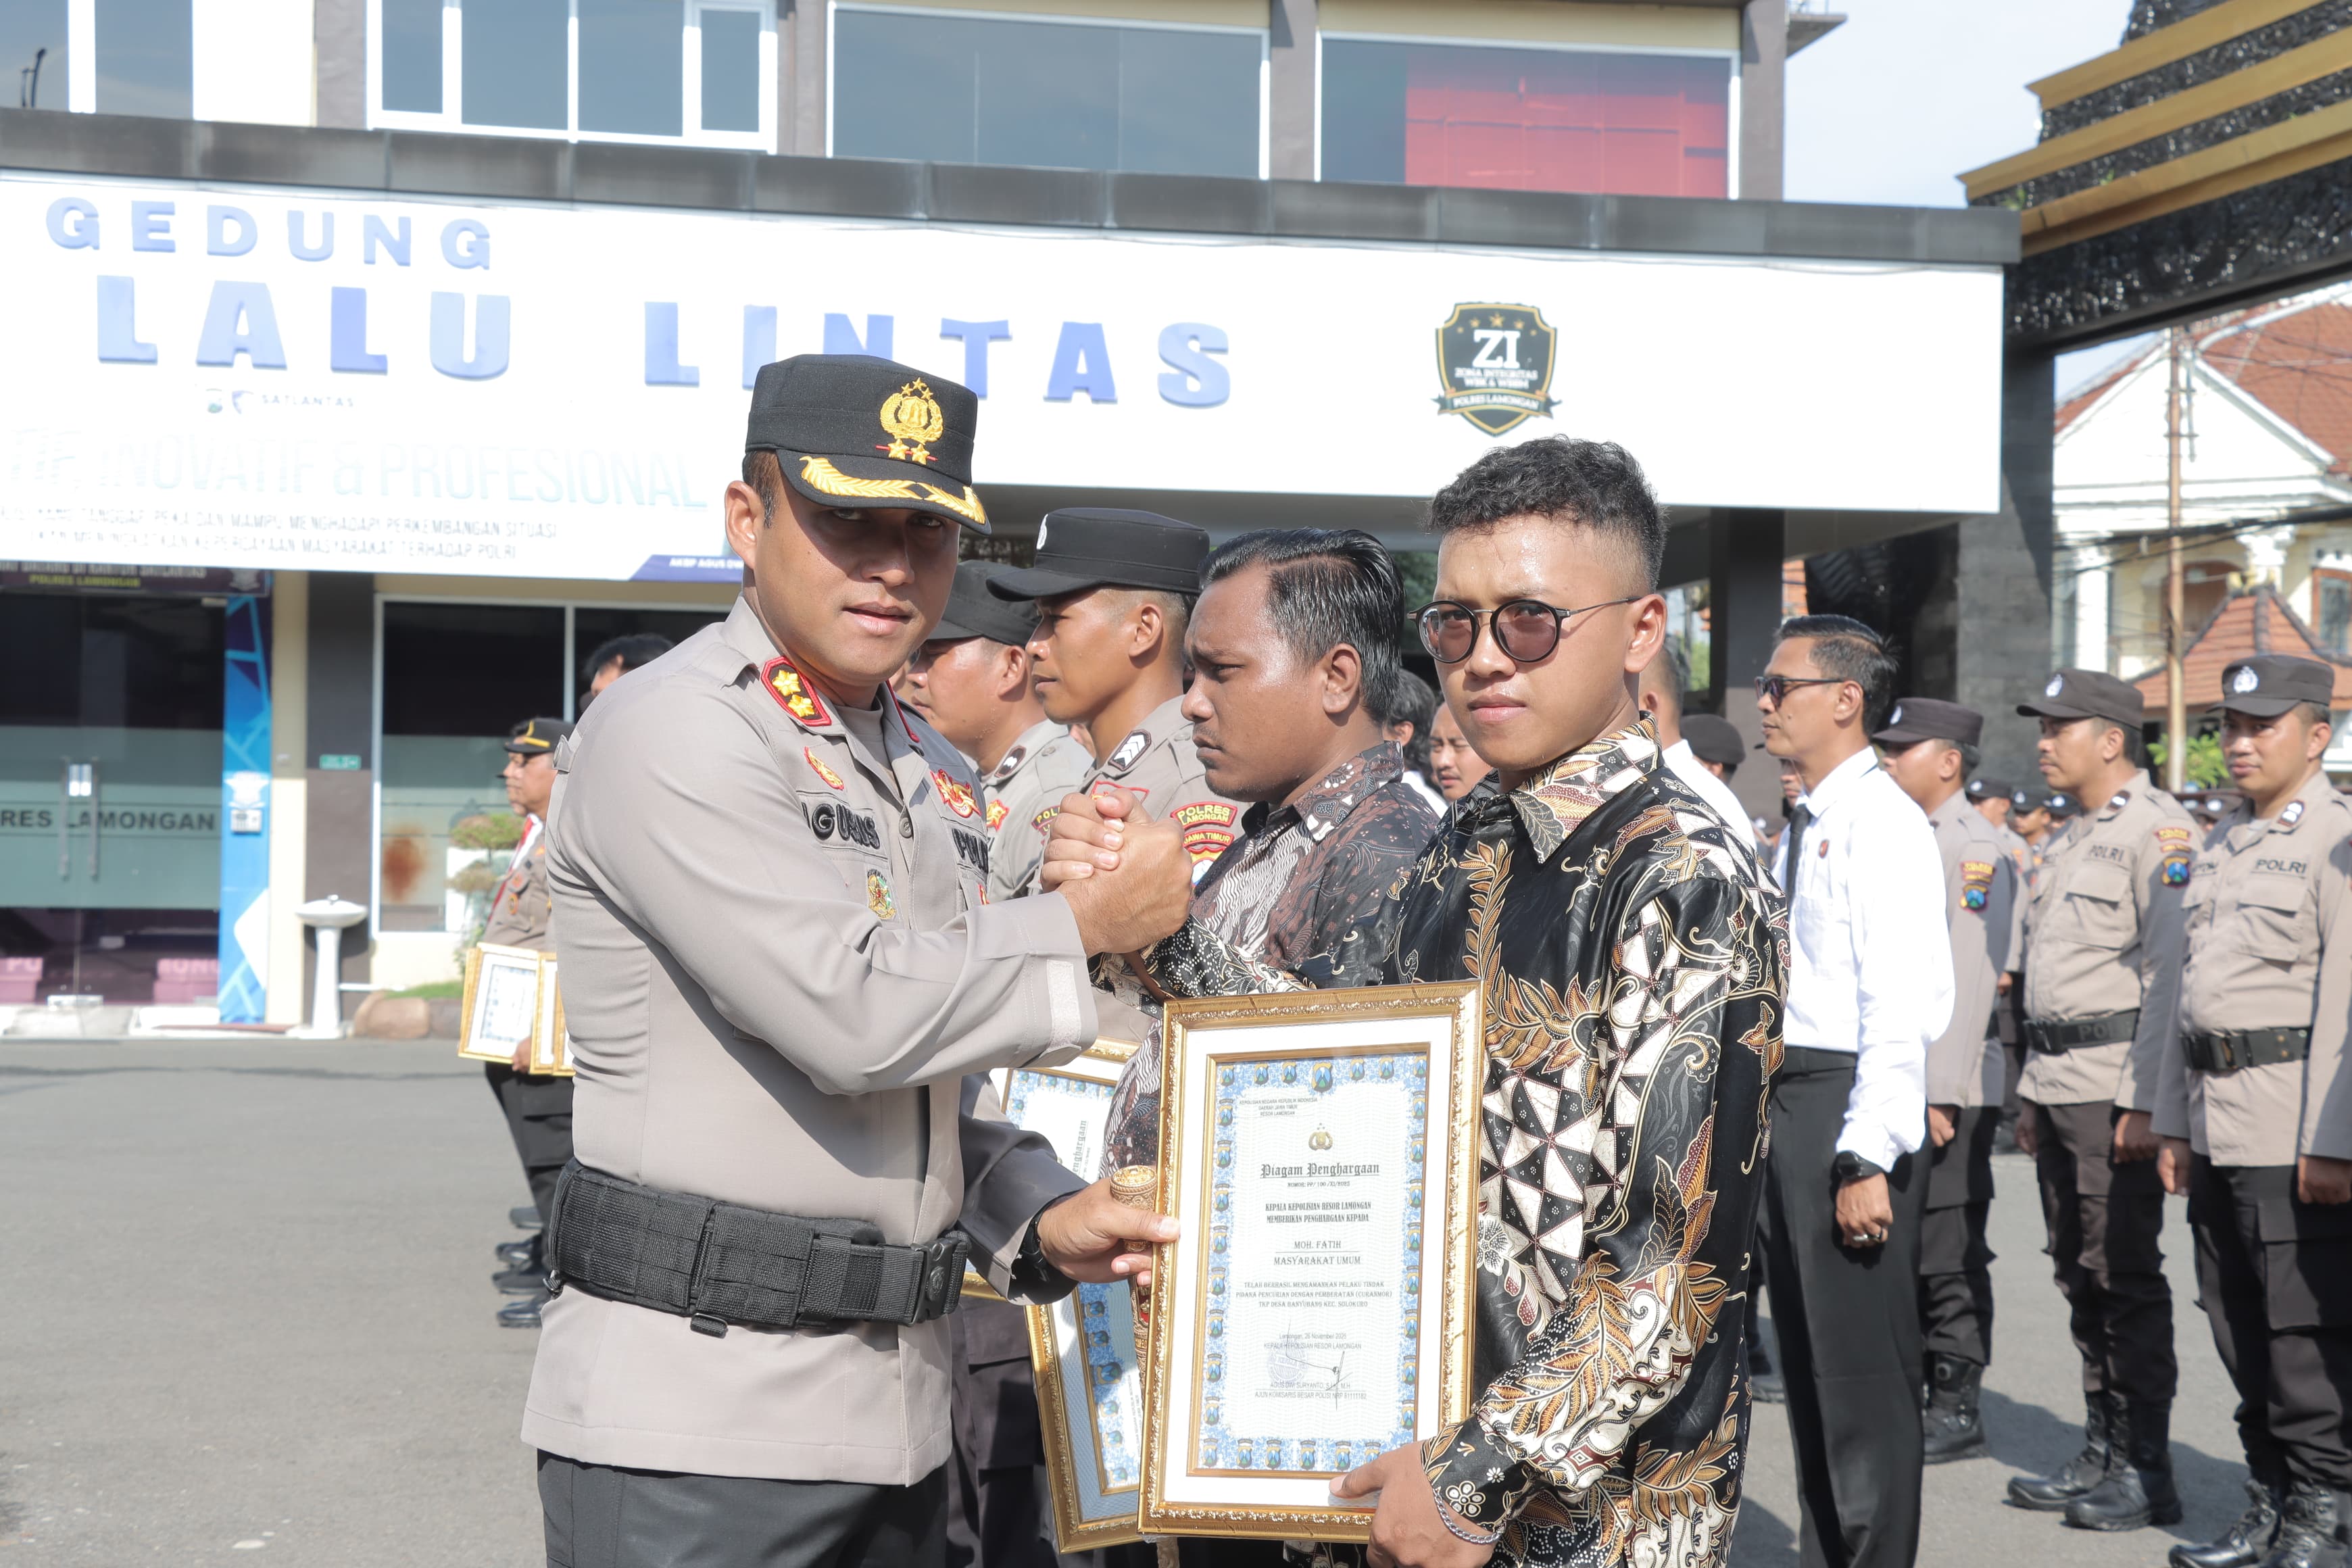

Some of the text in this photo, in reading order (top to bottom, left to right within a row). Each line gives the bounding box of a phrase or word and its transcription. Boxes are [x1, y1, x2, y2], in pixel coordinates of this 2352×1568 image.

[45, 197, 491, 270] GEDUNG
[97, 274, 1231, 409] LALU LINTAS
[1472, 328, 1521, 369] ZI
[379, 442, 708, 506] PROFESIONAL
[1178, 804, 1231, 820] POLRES
[1181, 813, 1229, 827] LAMONGAN
[1183, 832, 1231, 845] JAWA TIMUR
[2088, 843, 2125, 863] POLRI
[2255, 858, 2307, 875] POLRI
[1072, 1120, 1087, 1173] enghargaan
[1260, 1162, 1379, 1177] Piagam Penghargaan
[1265, 1201, 1371, 1211] KEPALA KEPOLISIAN RESOR LAMONGAN
[1267, 1213, 1369, 1223] MEMBERIKAN PENGHARGAAN KEPADA
[1294, 1240, 1341, 1249] MOH. FATIH
[1273, 1255, 1361, 1265] MASYARAKAT UMUM
